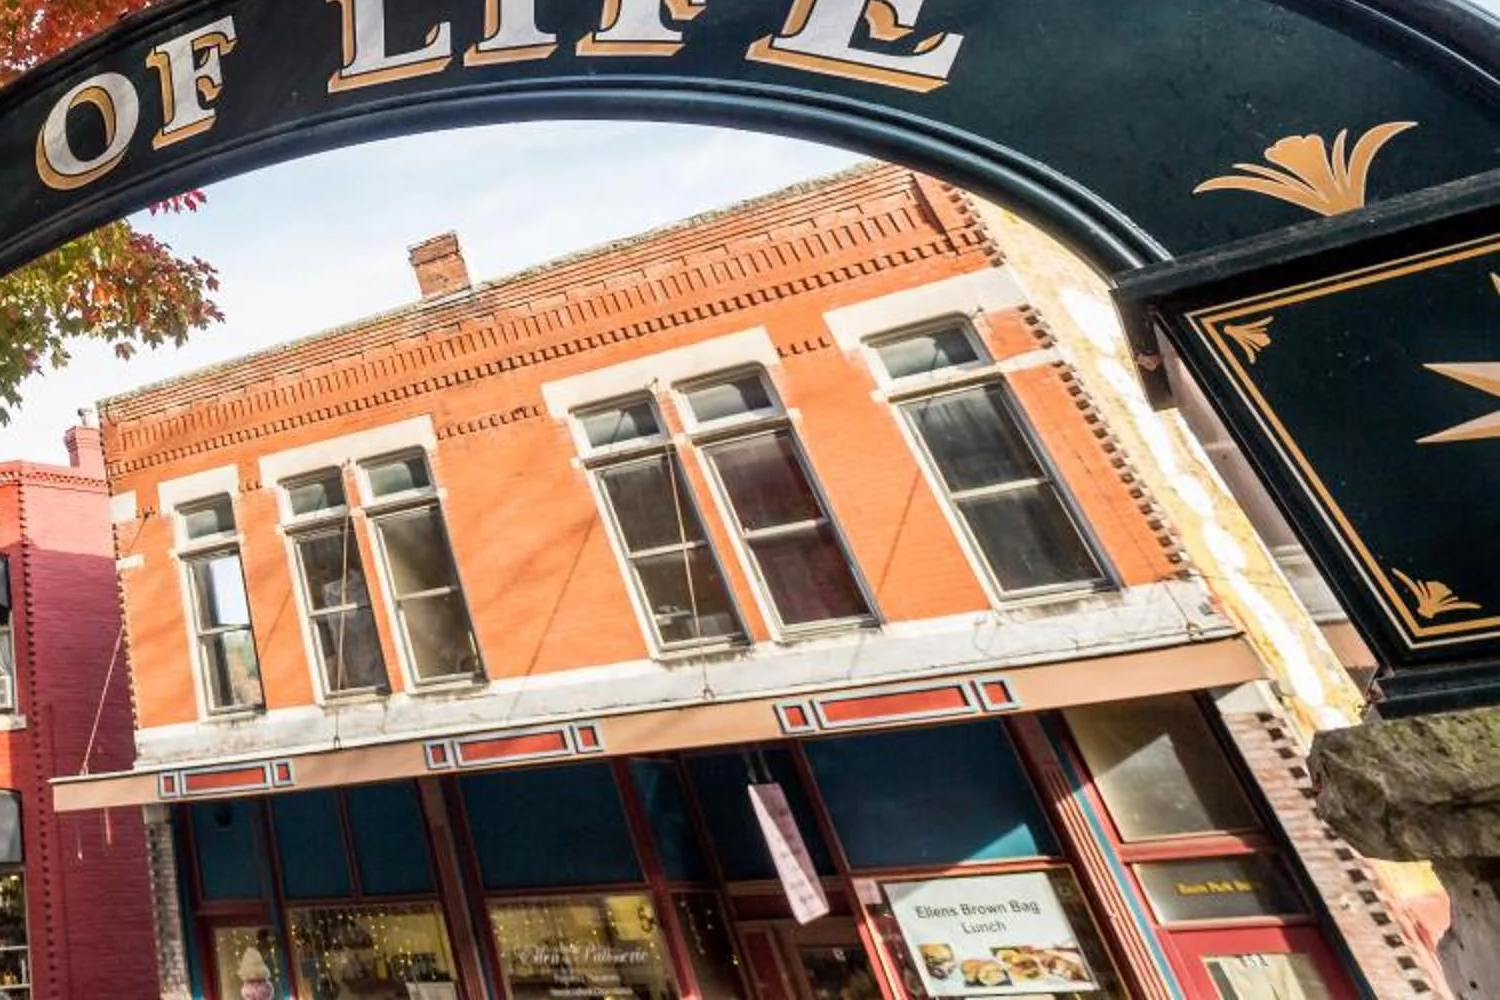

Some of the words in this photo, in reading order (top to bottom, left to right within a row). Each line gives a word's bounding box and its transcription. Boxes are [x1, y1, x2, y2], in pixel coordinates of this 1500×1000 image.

[35, 16, 238, 190] OF
[915, 904, 958, 919] Ellens
[960, 902, 1007, 916] Brown
[1009, 899, 1041, 915] Bag
[961, 921, 1007, 934] Lunch
